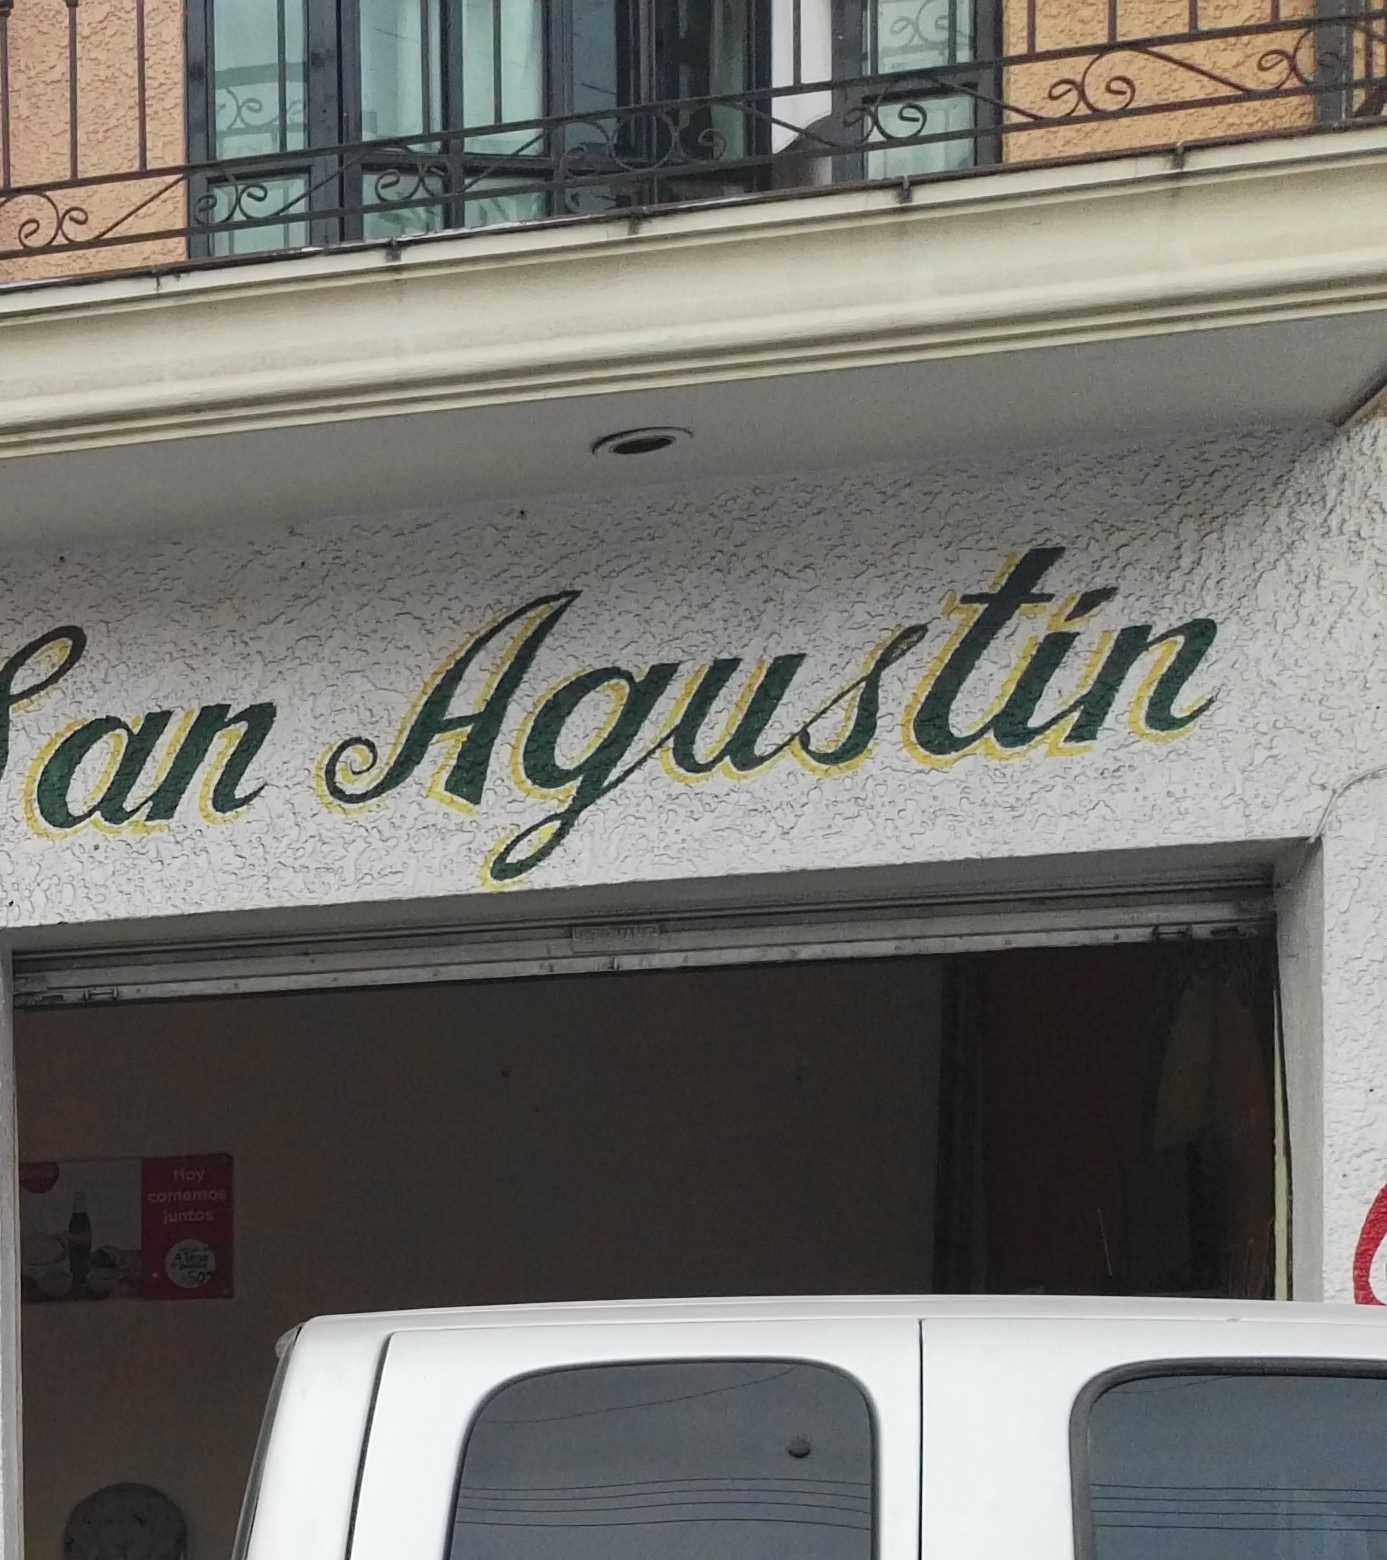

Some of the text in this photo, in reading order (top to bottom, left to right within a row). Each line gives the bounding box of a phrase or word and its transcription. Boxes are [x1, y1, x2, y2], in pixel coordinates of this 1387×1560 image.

[318, 546, 1218, 890] Agustín
[173, 1168, 206, 1183] Hoy
[147, 1189, 227, 1203] comemos
